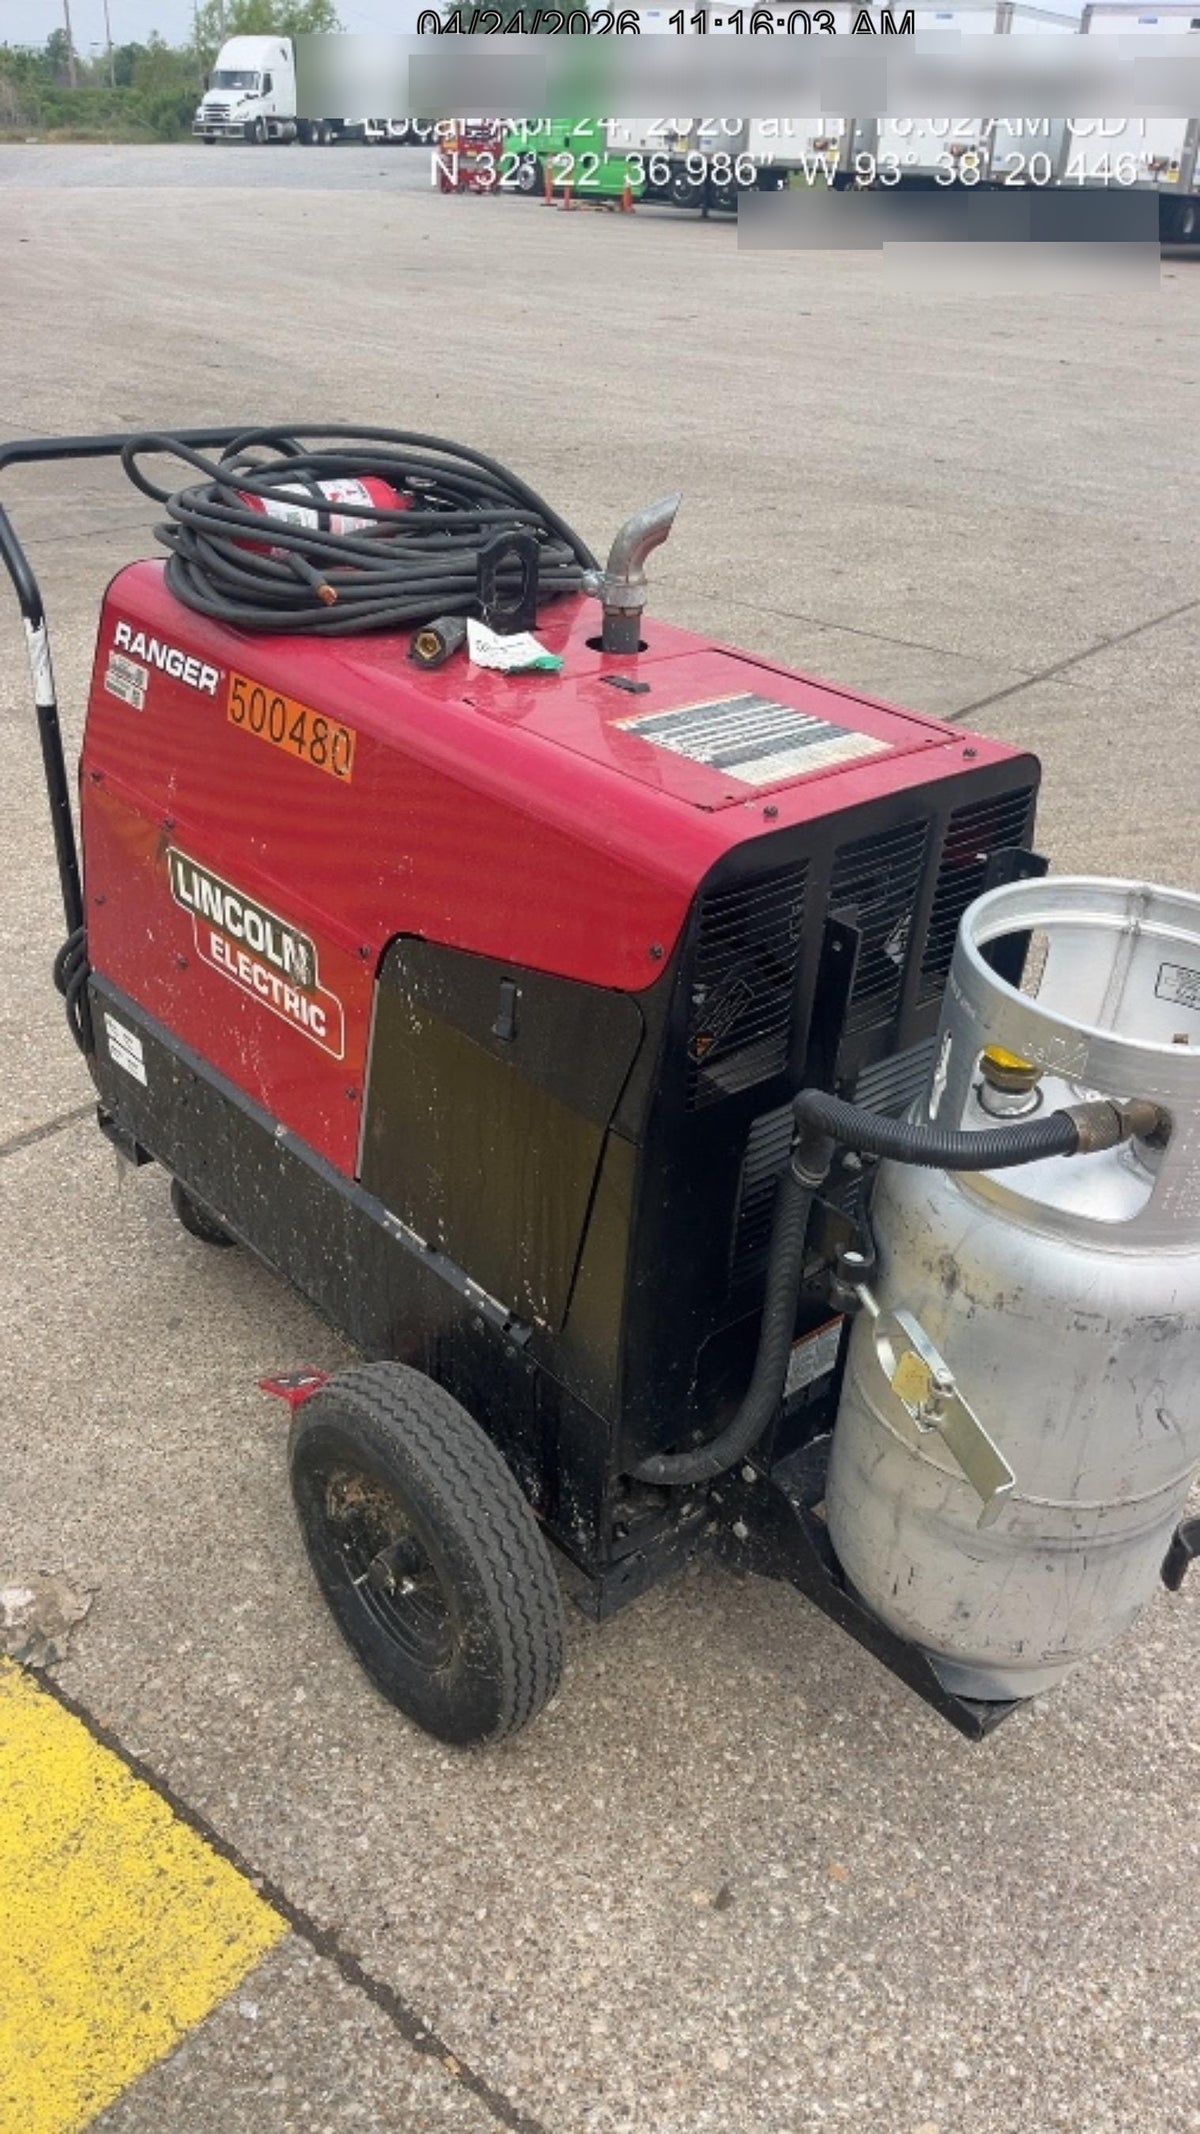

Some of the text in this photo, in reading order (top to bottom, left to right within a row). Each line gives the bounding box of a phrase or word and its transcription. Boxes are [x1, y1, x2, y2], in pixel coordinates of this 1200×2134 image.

[229, 678, 351, 776] 500480
[177, 861, 312, 985] LINCOLN
[209, 931, 327, 1037] ELECTRIC
